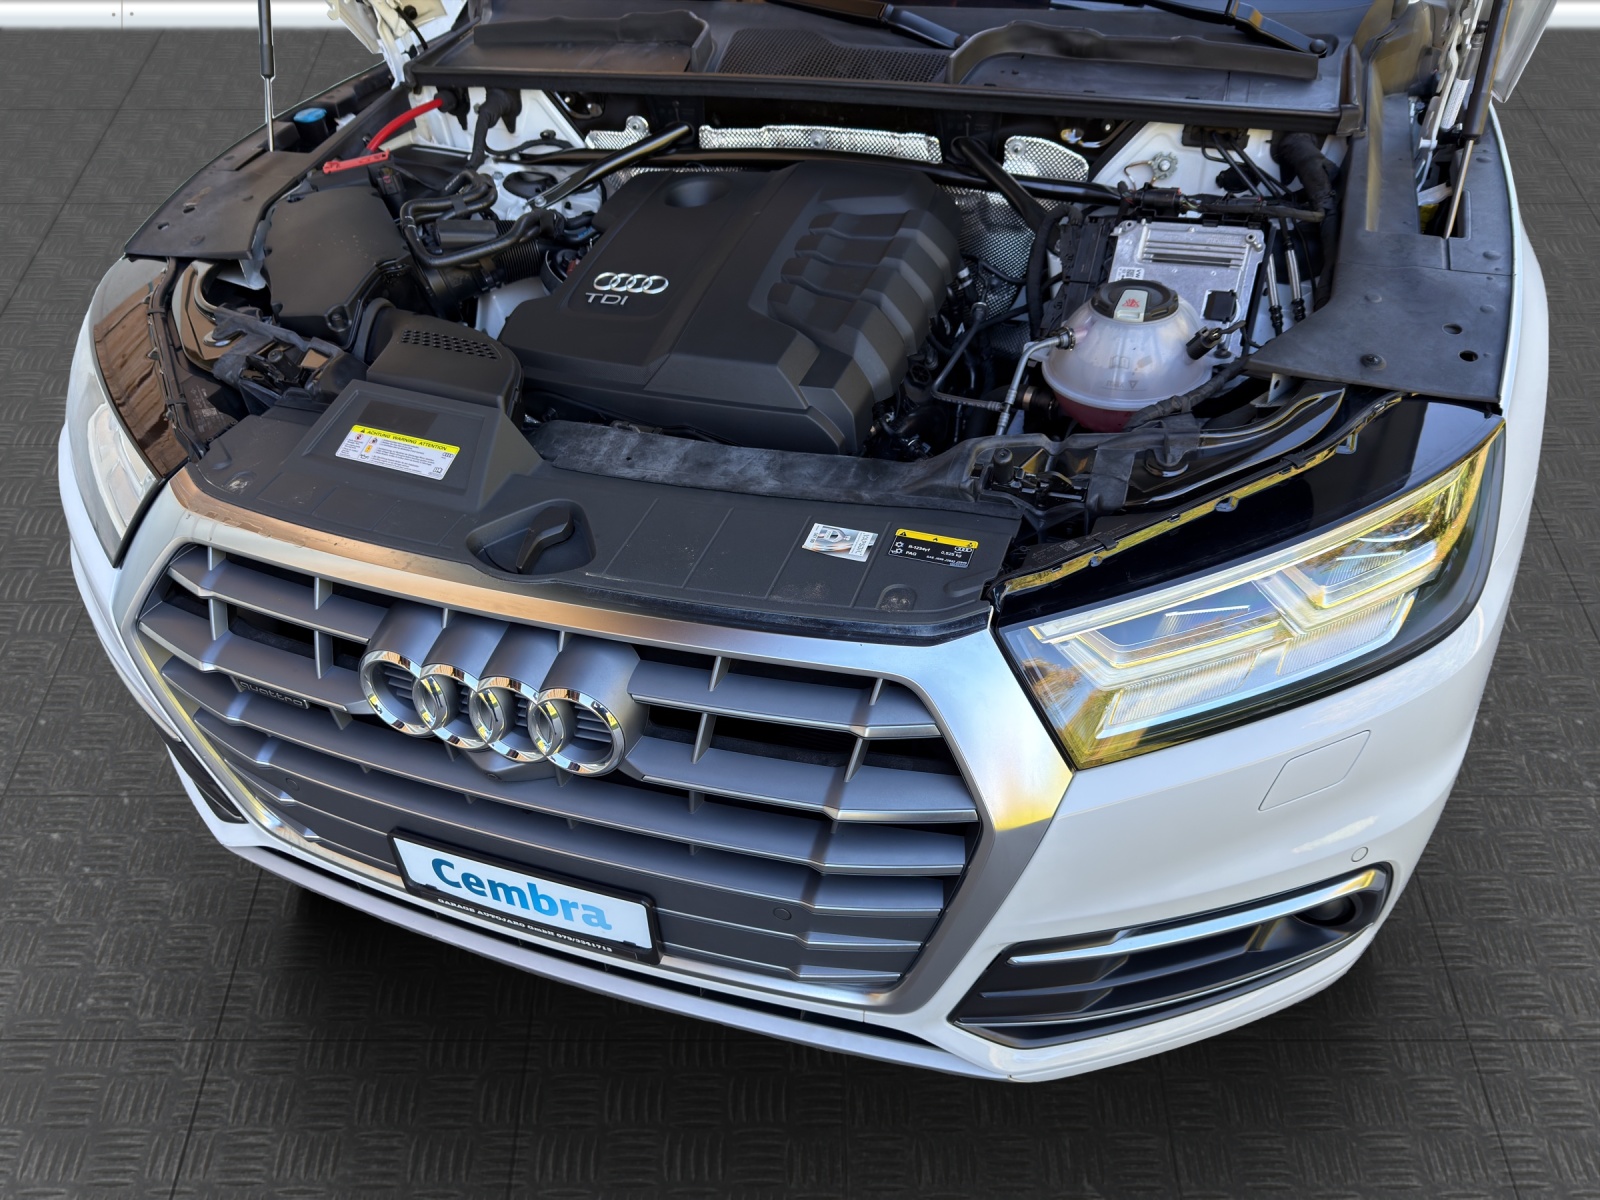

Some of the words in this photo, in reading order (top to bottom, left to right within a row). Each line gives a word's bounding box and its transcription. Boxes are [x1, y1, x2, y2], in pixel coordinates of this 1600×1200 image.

[585, 292, 629, 305] TDI
[367, 430, 391, 439] ACHTUNG
[392, 435, 417, 444] WARNING
[419, 440, 447, 451] ATTENTION
[240, 681, 303, 707] quattro
[431, 857, 613, 931] Cembra
[437, 898, 476, 913] GARAGE
[527, 924, 555, 937] GmbH
